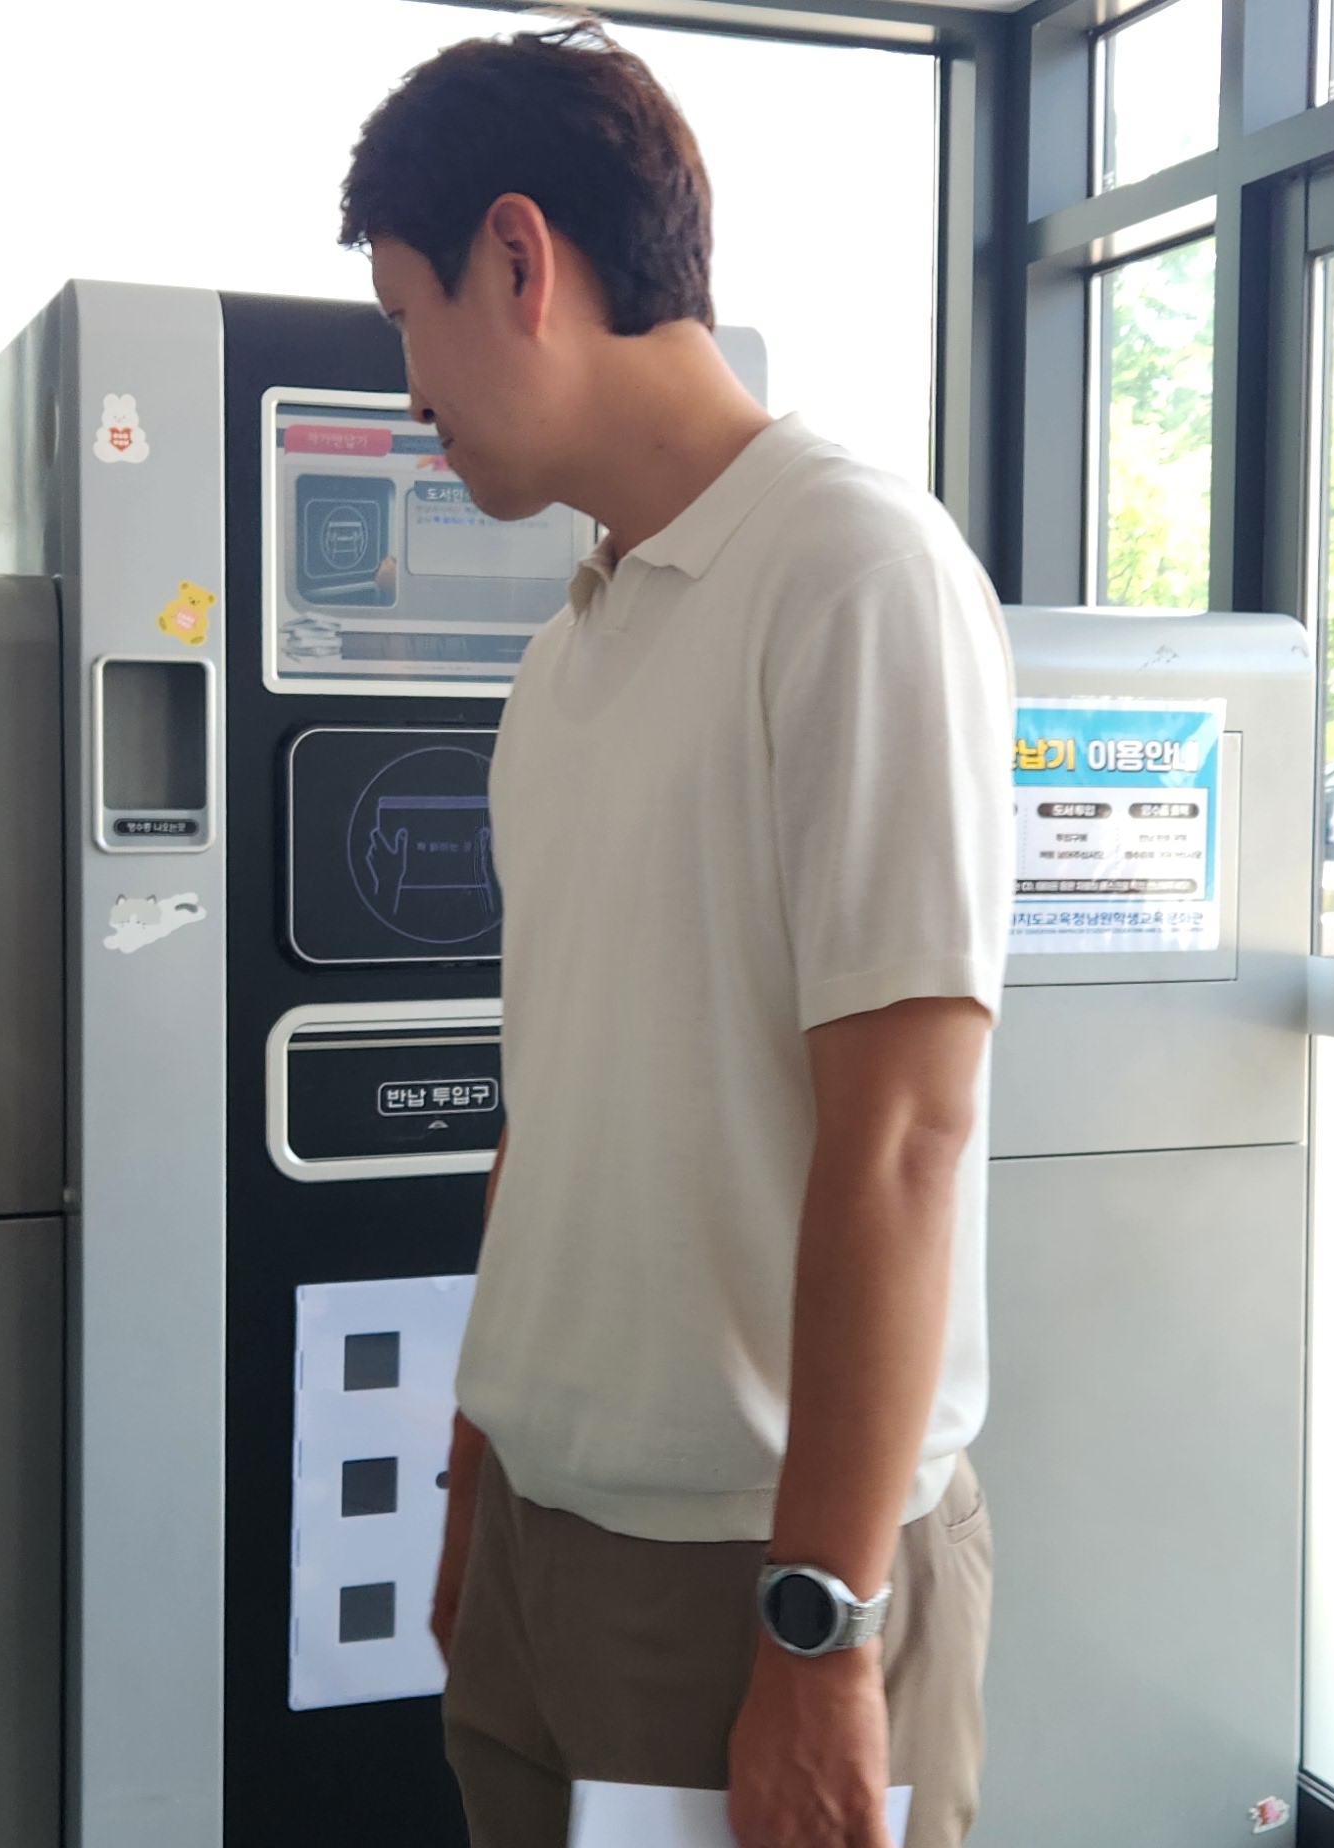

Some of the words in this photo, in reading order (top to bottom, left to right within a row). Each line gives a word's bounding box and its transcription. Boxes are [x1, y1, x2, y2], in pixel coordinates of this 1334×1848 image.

[1087, 740, 1199, 773] 이용안내
[386, 1088, 425, 1108] 반납
[431, 1086, 491, 1106] 투입구
